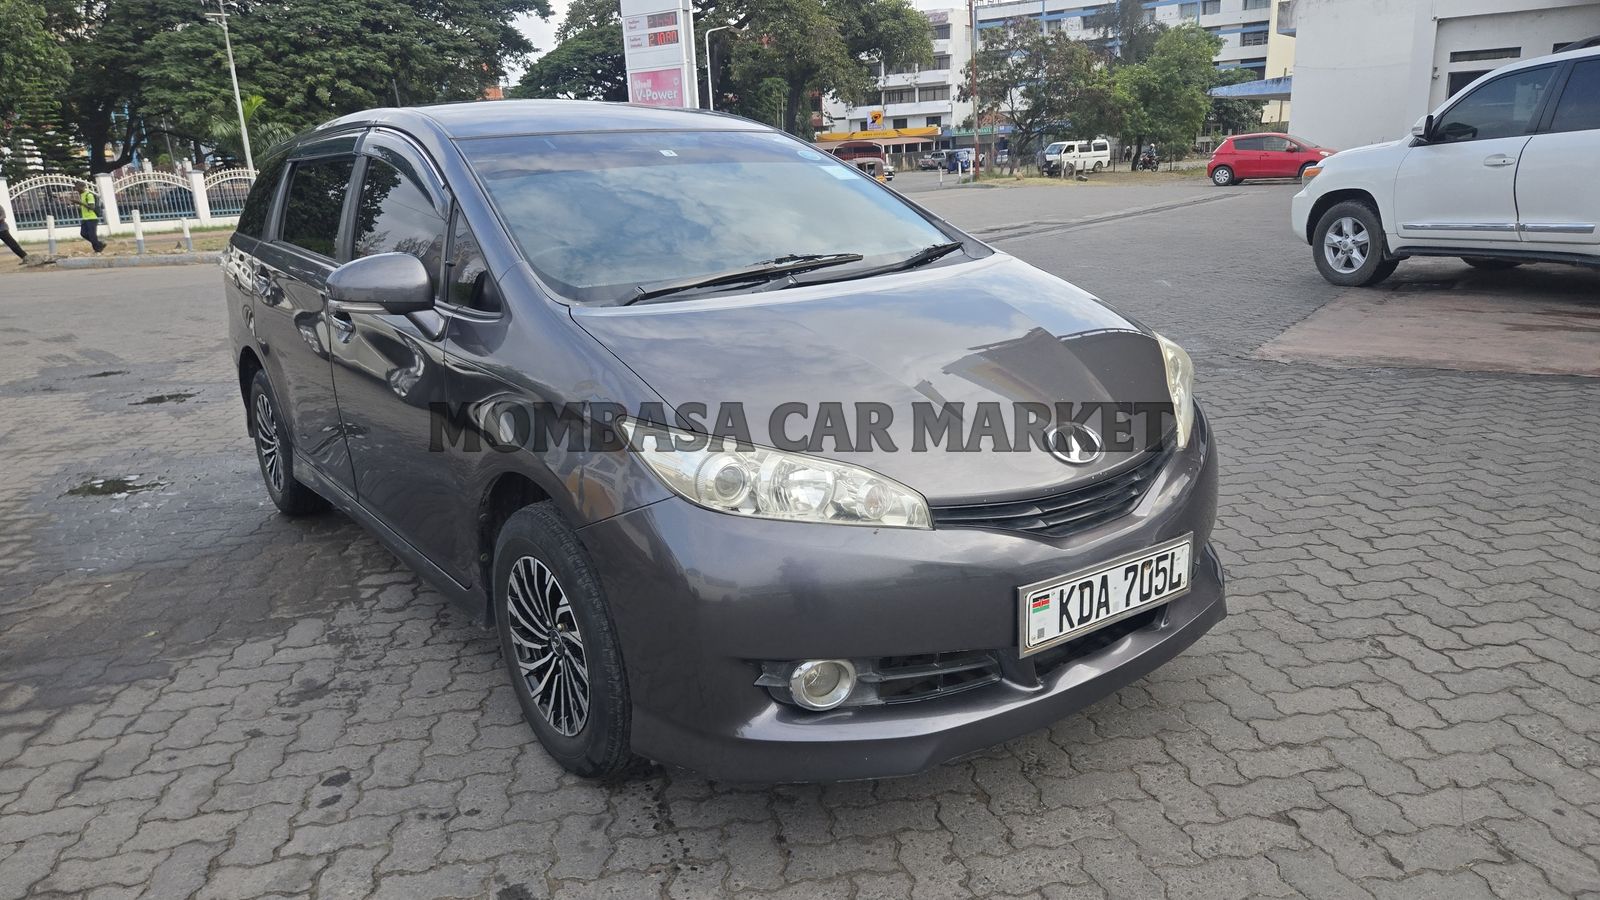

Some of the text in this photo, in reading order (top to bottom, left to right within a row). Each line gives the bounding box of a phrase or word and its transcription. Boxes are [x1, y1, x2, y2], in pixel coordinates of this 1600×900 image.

[635, 89, 678, 101] V-Power
[1058, 552, 1182, 633] KDA 705L
